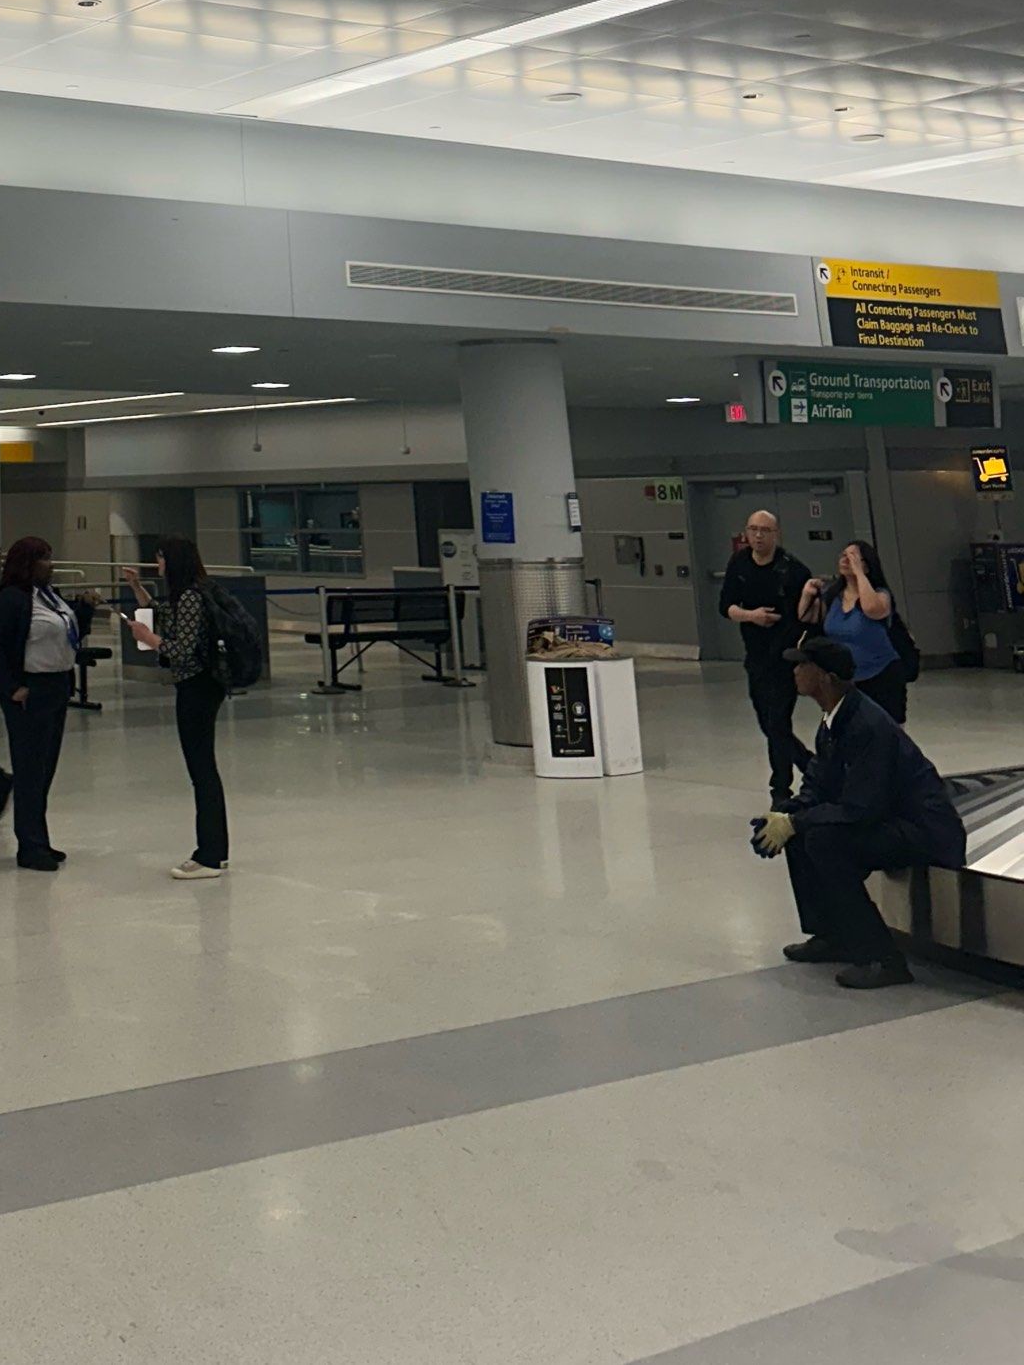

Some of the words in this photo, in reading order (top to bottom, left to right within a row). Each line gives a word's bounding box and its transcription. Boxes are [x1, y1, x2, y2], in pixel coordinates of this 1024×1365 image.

[850, 266, 884, 279] Intransit
[852, 280, 896, 295] Connecting
[898, 284, 941, 297] Passengers
[856, 302, 866, 313] All
[868, 303, 912, 319] Connecting
[914, 307, 956, 322] Passengers
[957, 309, 977, 321] Must
[856, 319, 878, 330] Claim
[880, 319, 914, 335] Baggage
[916, 323, 930, 333] and
[932, 324, 967, 335] Re-Check
[969, 326, 978, 335] to
[858, 335, 877, 345] Final
[878, 335, 924, 347] Destination
[809, 373, 850, 387] Ground
[853, 373, 930, 391] Transportation
[972, 379, 991, 393] Exit
[844, 391, 856, 401] por
[812, 403, 852, 419] AirTrain
[657, 485, 667, 500] 8
[670, 485, 683, 500] M
